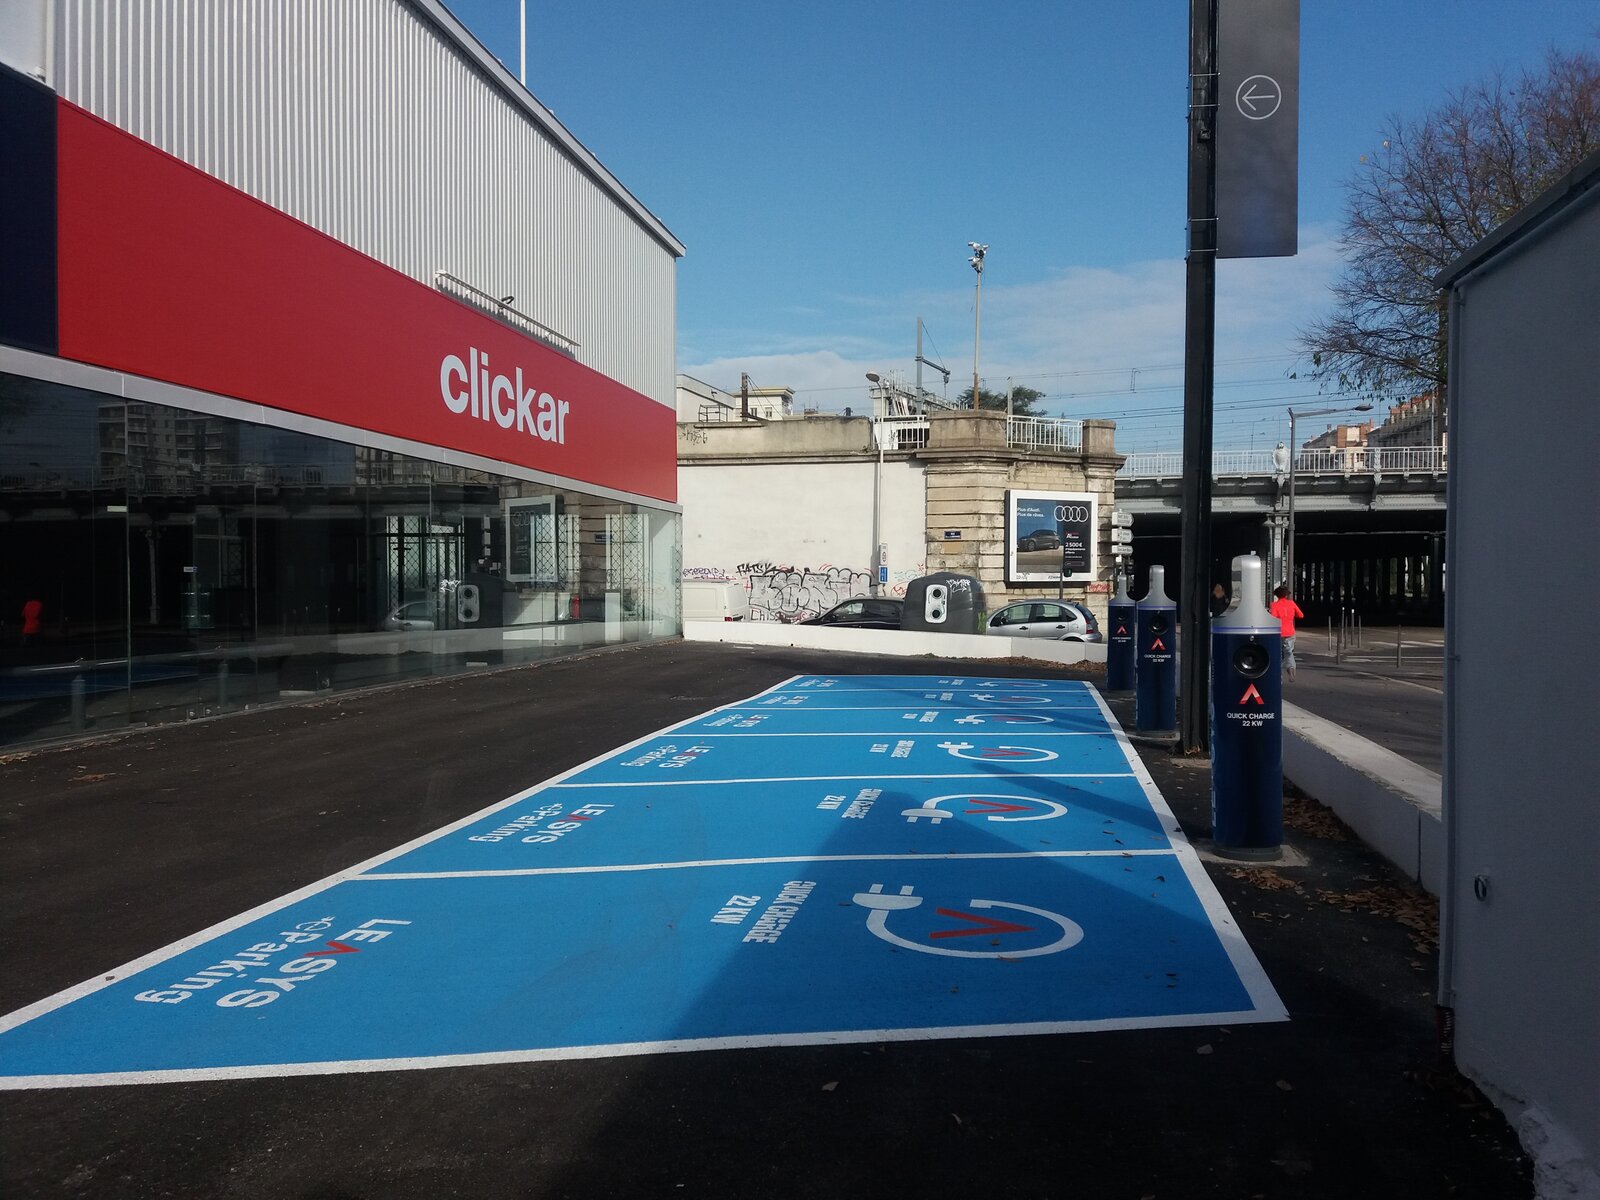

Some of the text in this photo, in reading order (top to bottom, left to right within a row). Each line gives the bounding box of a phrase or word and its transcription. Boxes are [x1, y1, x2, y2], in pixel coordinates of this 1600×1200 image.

[440, 346, 570, 445] clickar
[1248, 712, 1275, 720] CHARGE
[710, 895, 762, 925] 22 KW
[742, 880, 817, 944] QUICK CHARGE
